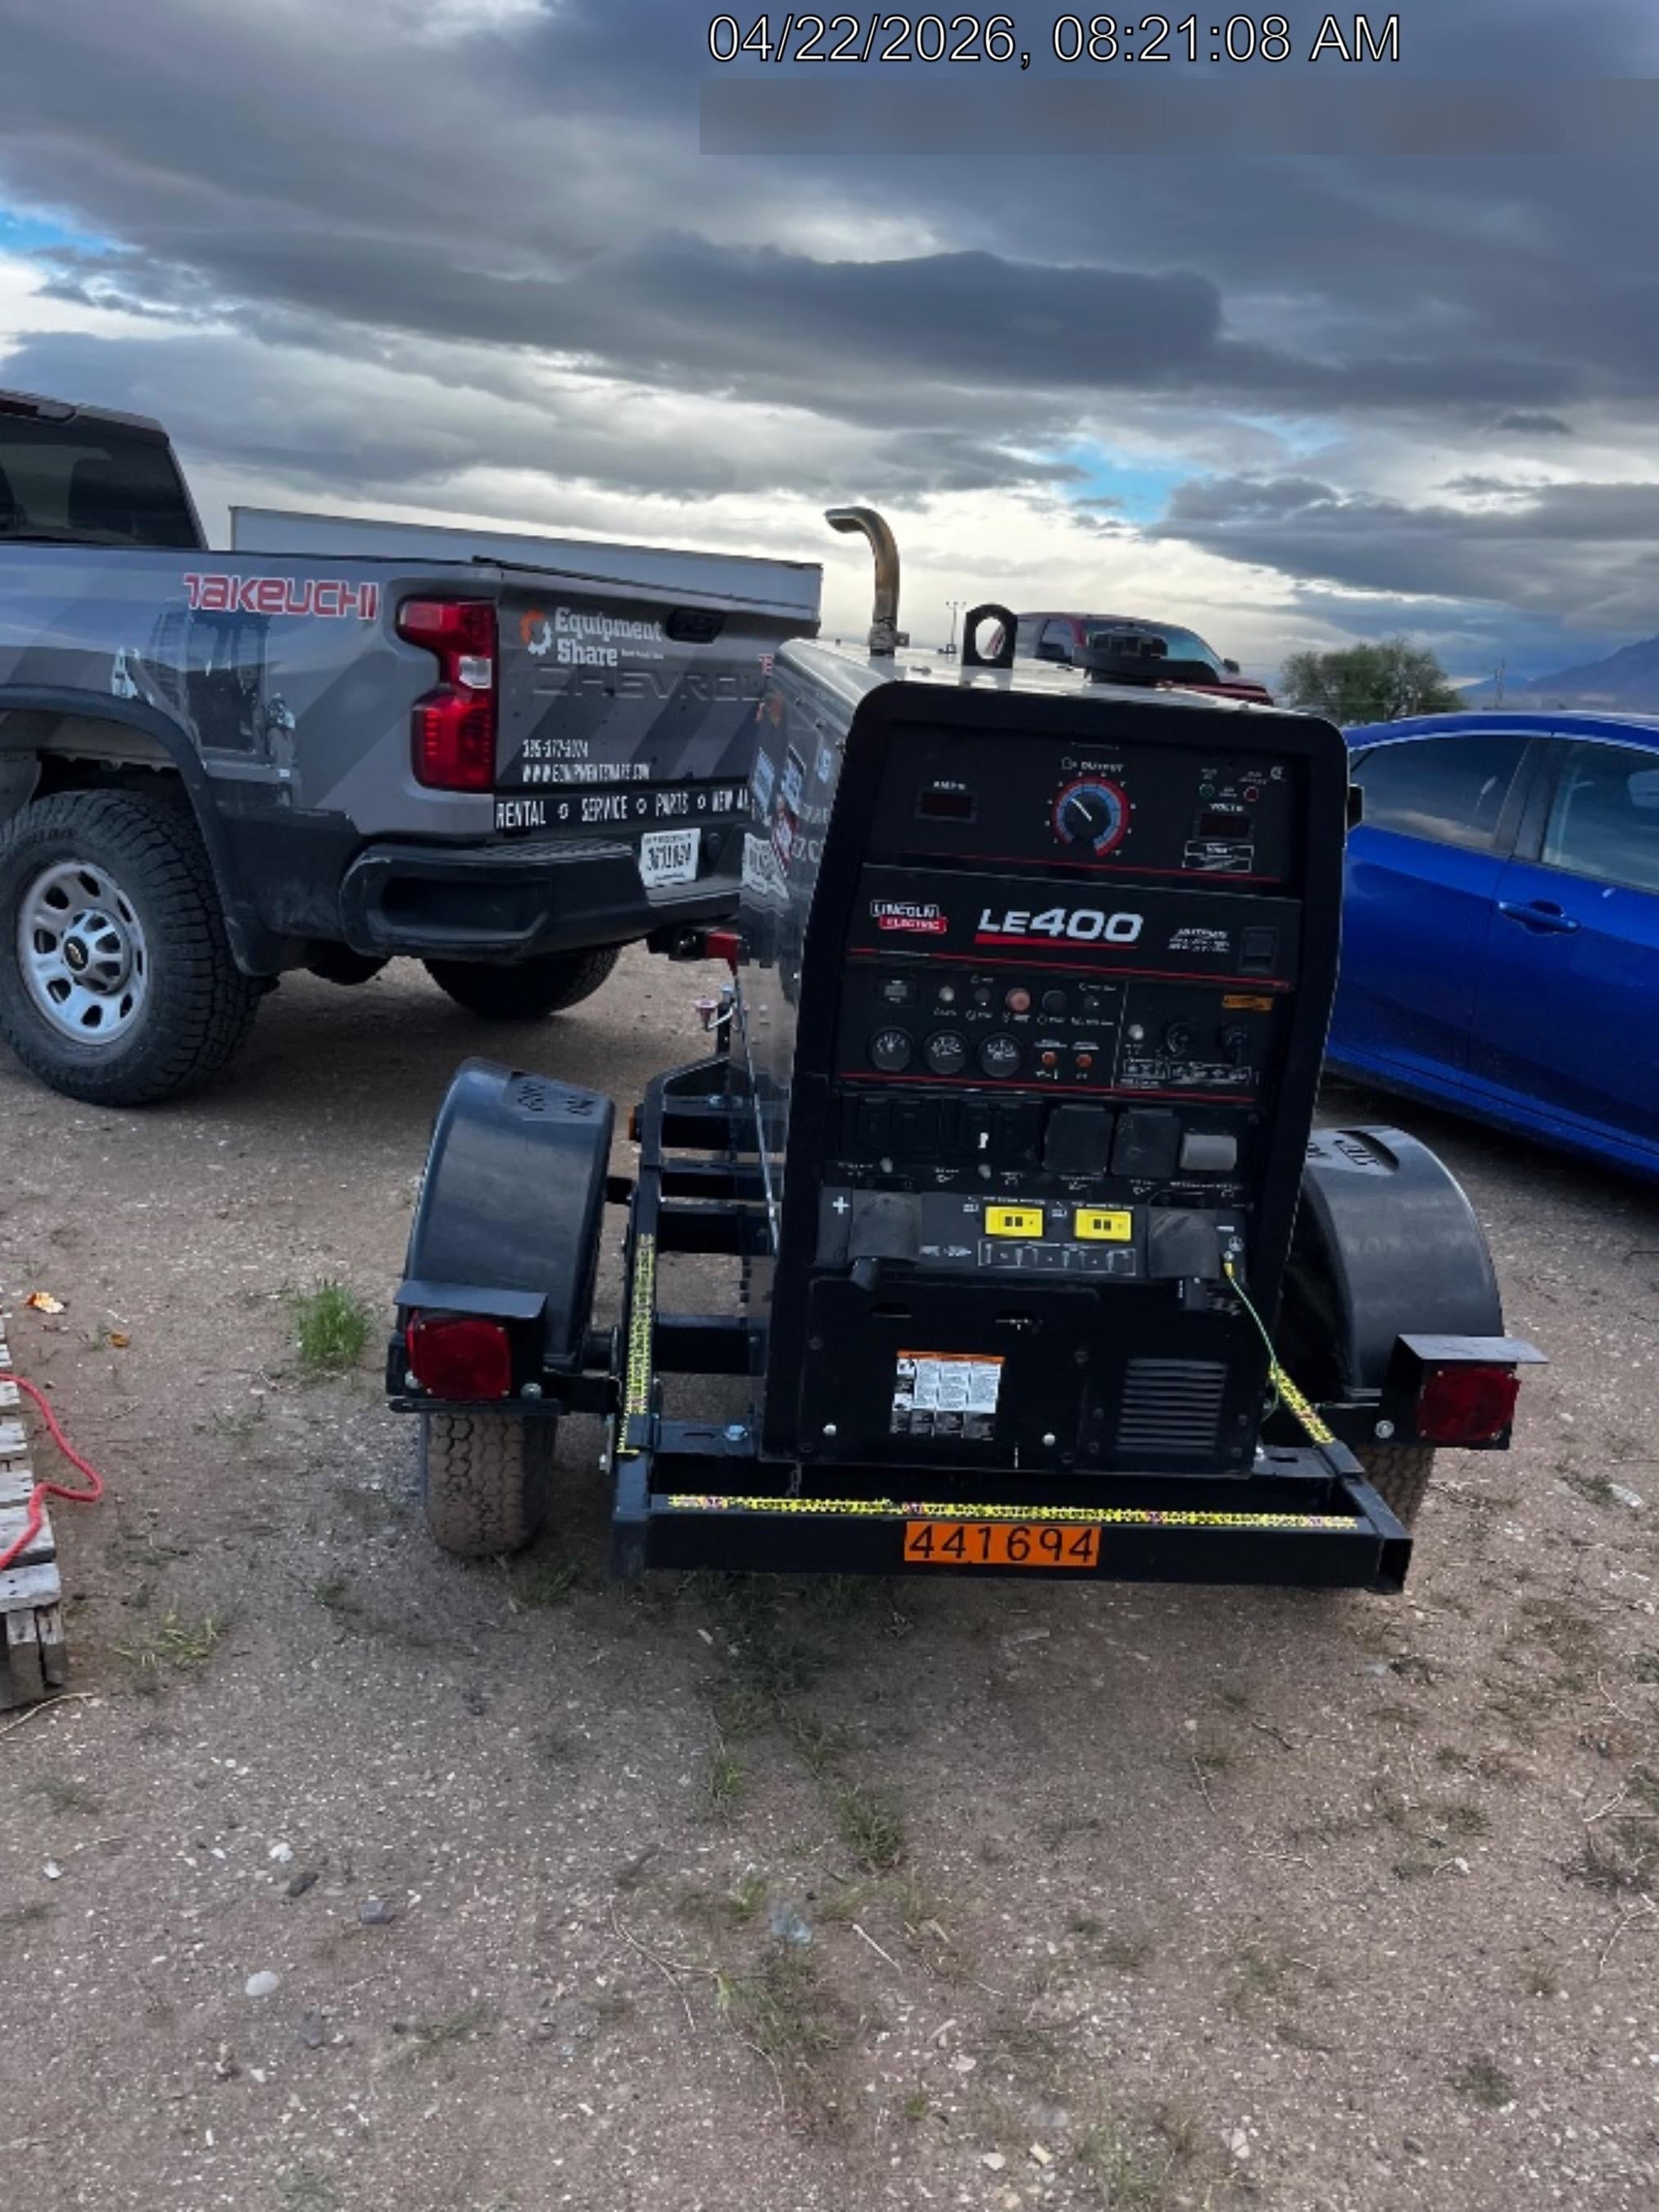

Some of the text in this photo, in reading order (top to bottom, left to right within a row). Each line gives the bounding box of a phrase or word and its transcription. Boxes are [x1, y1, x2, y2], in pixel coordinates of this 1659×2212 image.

[555, 607, 663, 642] Equipment
[557, 638, 618, 667] Share
[496, 800, 546, 829] RENTAL
[582, 796, 628, 823] SERVICE
[655, 791, 690, 818] PARTS
[873, 903, 936, 918] LINCOLN
[886, 918, 941, 931] ELECTRIC
[977, 909, 1144, 943] LE400
[909, 1524, 1093, 1563] 441694
